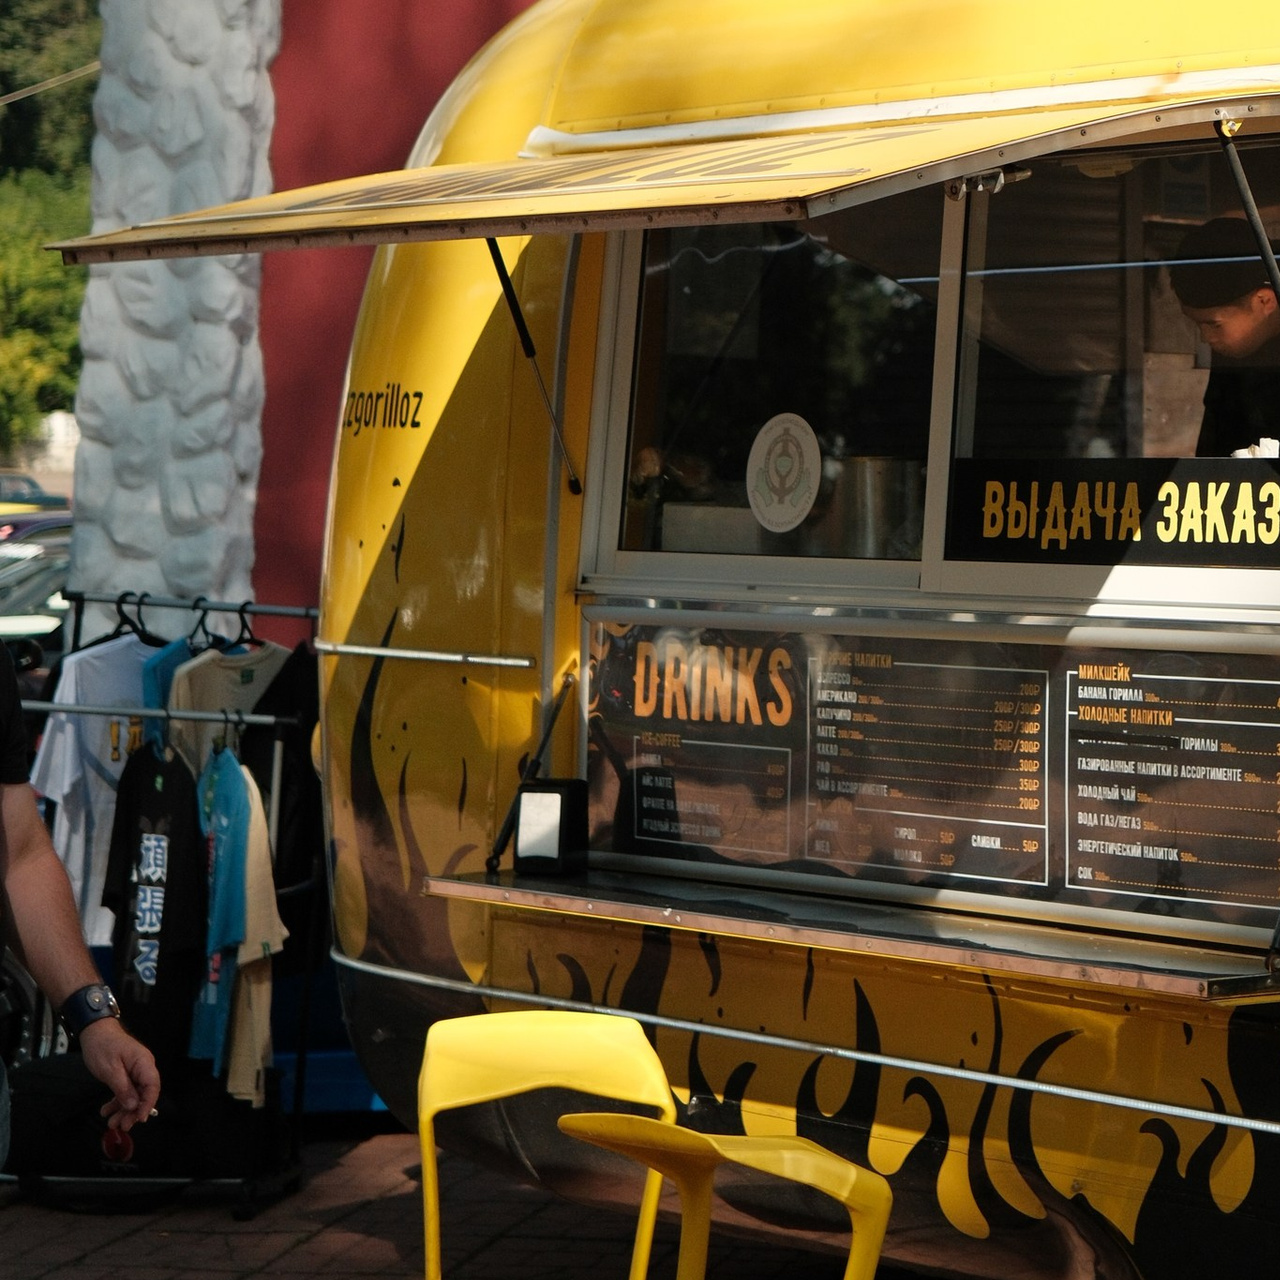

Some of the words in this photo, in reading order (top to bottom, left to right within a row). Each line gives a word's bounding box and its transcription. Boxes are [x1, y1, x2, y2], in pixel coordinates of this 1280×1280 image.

[343, 383, 424, 437] zgorilloz
[982, 480, 1142, 550] ВЫДАЧА
[1079, 663, 1130, 681] МИЛКШЕЙК
[633, 641, 792, 726] DRINKS
[1078, 686, 1107, 700] БАНАНА
[1109, 688, 1143, 701] ГОРИЛЛА
[1078, 706, 1127, 724] ХОЛОДНЫЕ
[1130, 709, 1173, 726] НАПИТКИ
[816, 725, 837, 738] ЛАТТЕ
[1180, 737, 1218, 752] ГОРИЛЛЫ
[1078, 757, 1135, 774] ГАЗИРОВАННЫЕ
[1137, 762, 1172, 776] НАПИТКИ
[1173, 764, 1178, 776] В
[1181, 765, 1242, 782] АССОРТИМЕНТЕ
[1078, 785, 1119, 801] ХОЛОДНЫЙ
[1121, 786, 1136, 802] ЧАЙ
[1078, 812, 1098, 827] ВОДА
[1101, 814, 1141, 830] ГАЗ/НЕГАЗ
[1078, 839, 1141, 858] ЭНЕРГЕТИЧЕСКИЙ
[1144, 846, 1178, 862] НАПИТОК
[1078, 867, 1093, 880] СОК
